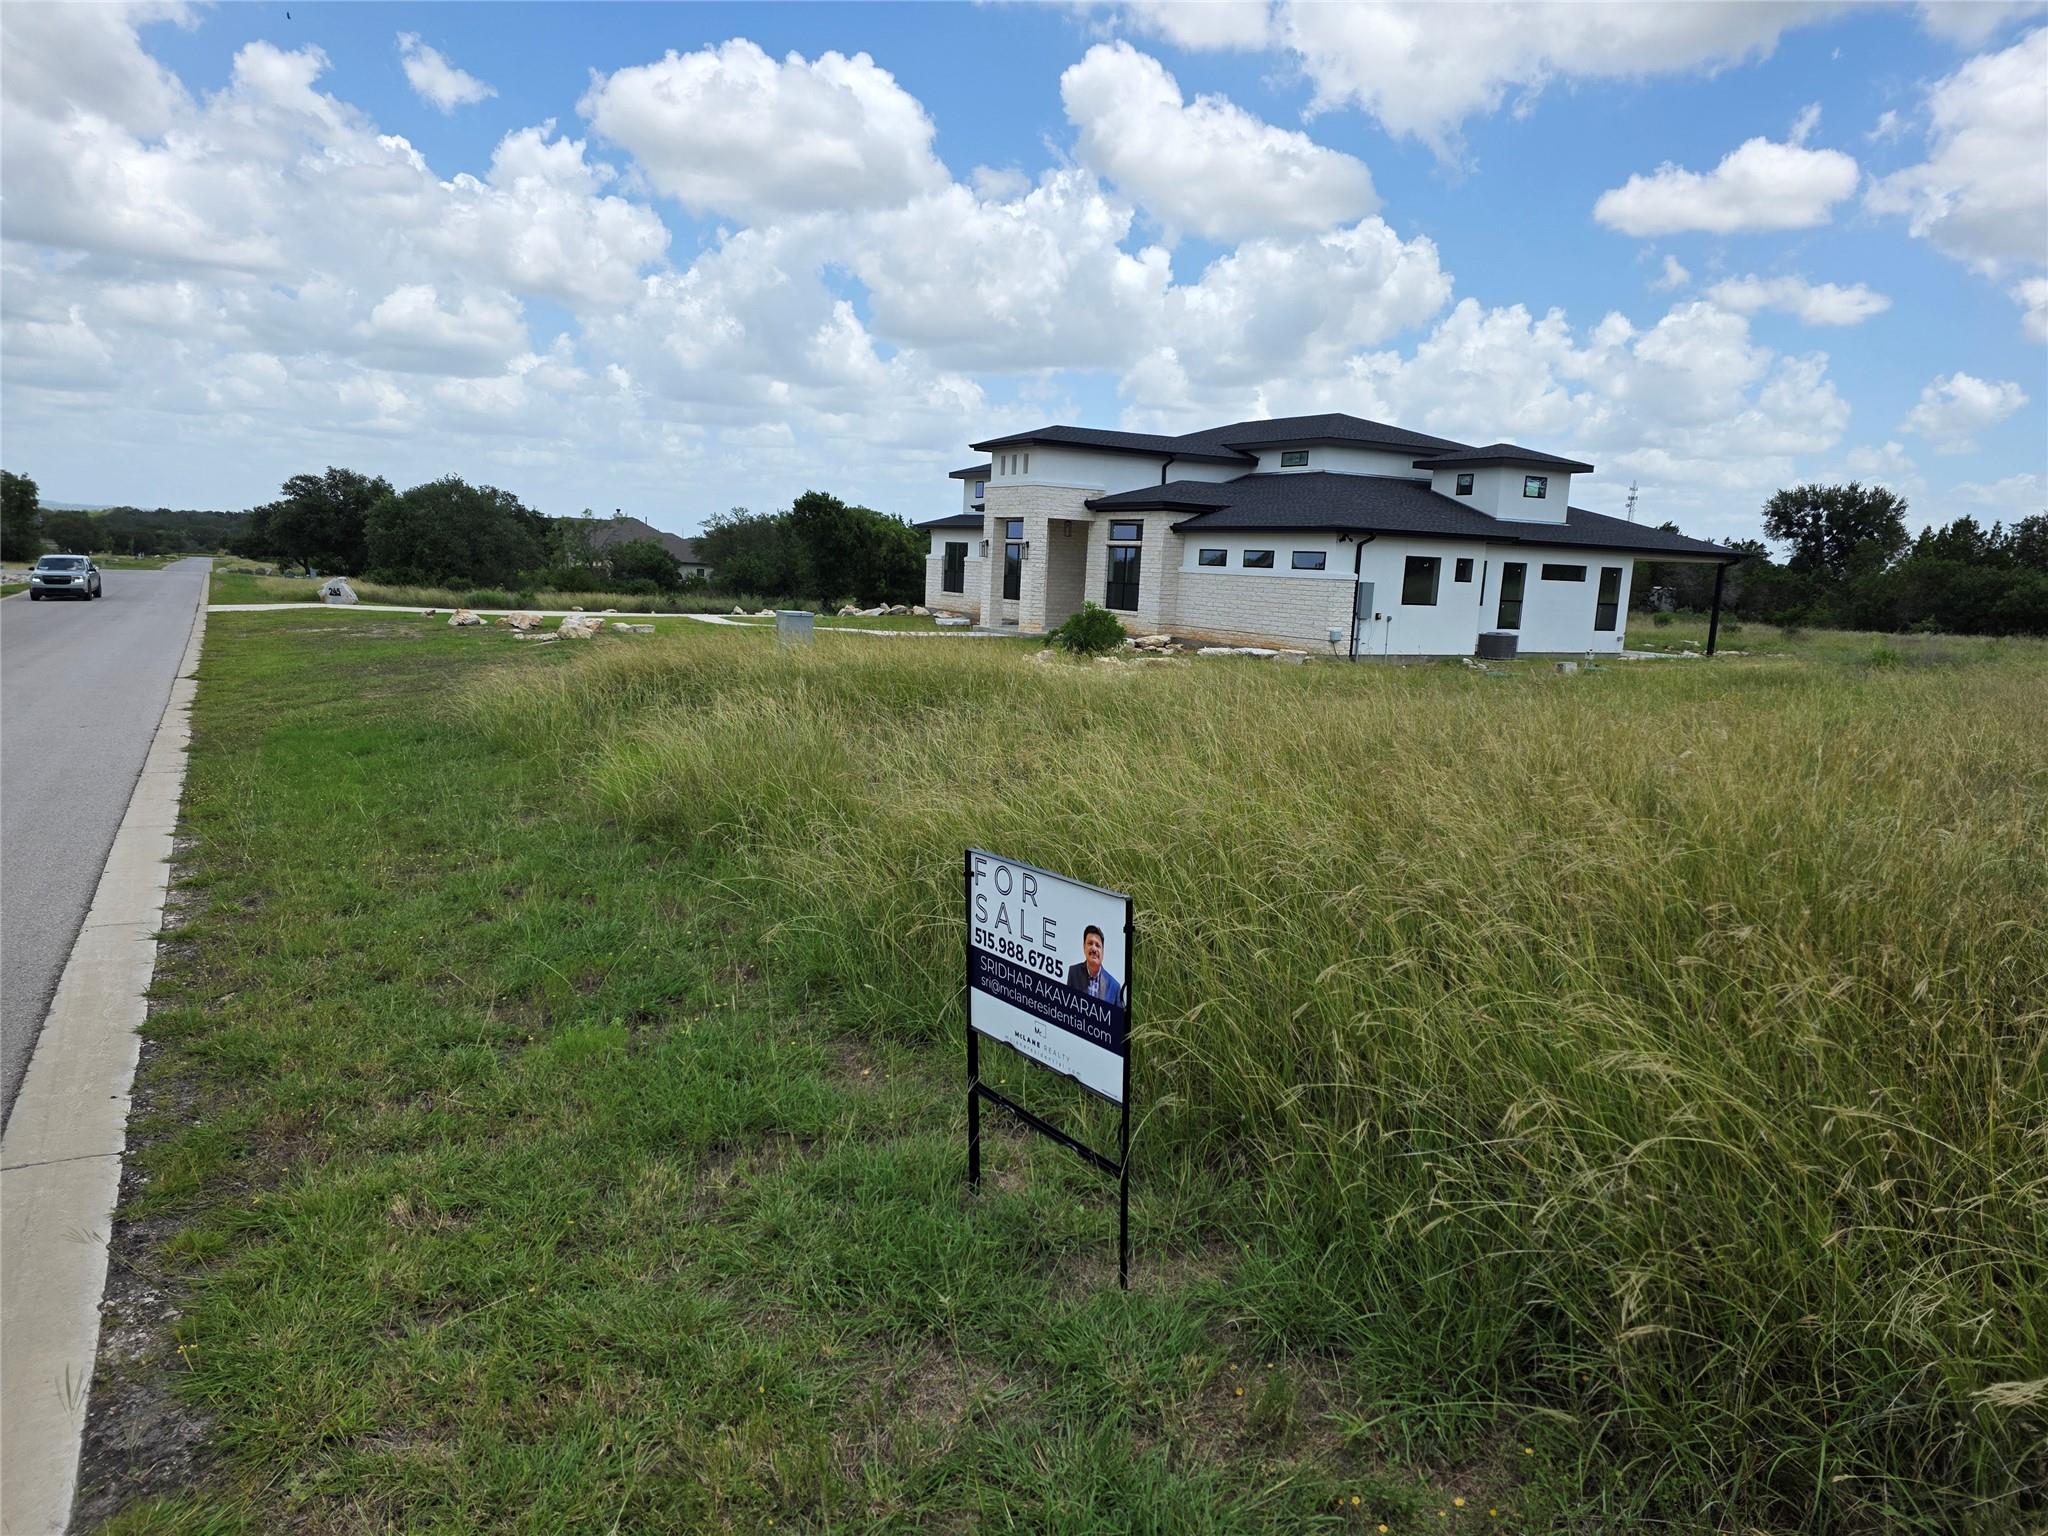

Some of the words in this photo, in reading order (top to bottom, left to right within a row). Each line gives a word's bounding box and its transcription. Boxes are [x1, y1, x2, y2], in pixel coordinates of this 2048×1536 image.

[975, 857, 1038, 907] FOR
[975, 893, 1056, 952] SALE
[975, 927, 1063, 978] 515.988.6785
[980, 955, 1033, 991] SRIDHAR
[1035, 981, 1111, 1026] AKAVARAM
[981, 976, 1112, 1044] sri@mclaneresidential.com
